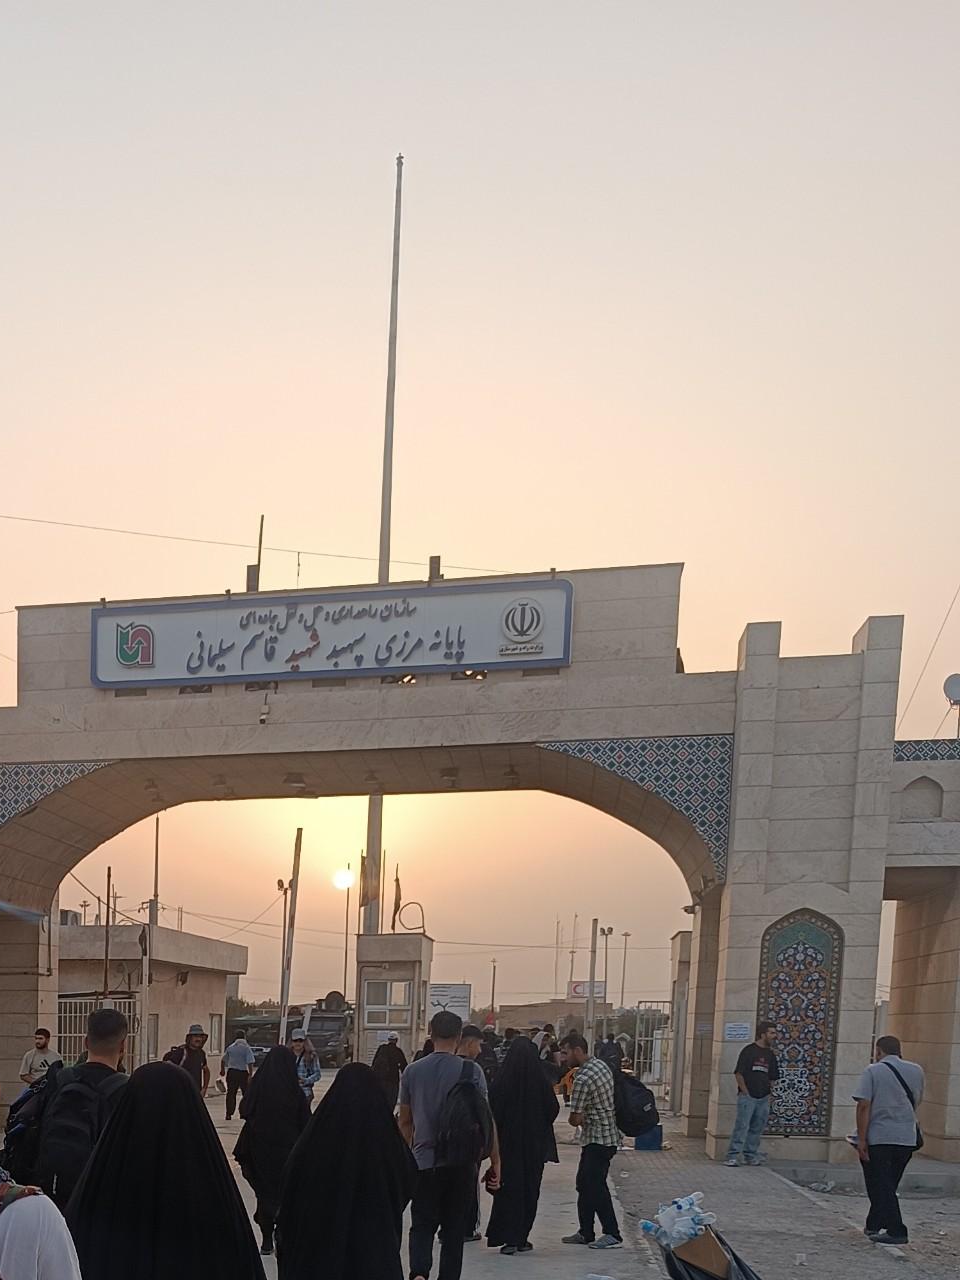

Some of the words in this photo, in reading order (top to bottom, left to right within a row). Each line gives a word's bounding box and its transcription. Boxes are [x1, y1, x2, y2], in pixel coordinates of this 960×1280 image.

[186, 630, 235, 675] سلیمانی
[240, 630, 278, 671] قاسم
[284, 629, 320, 672] شهید
[325, 632, 367, 668] سپهبد
[374, 630, 424, 667] مرزی
[429, 625, 467, 664] پایانه
